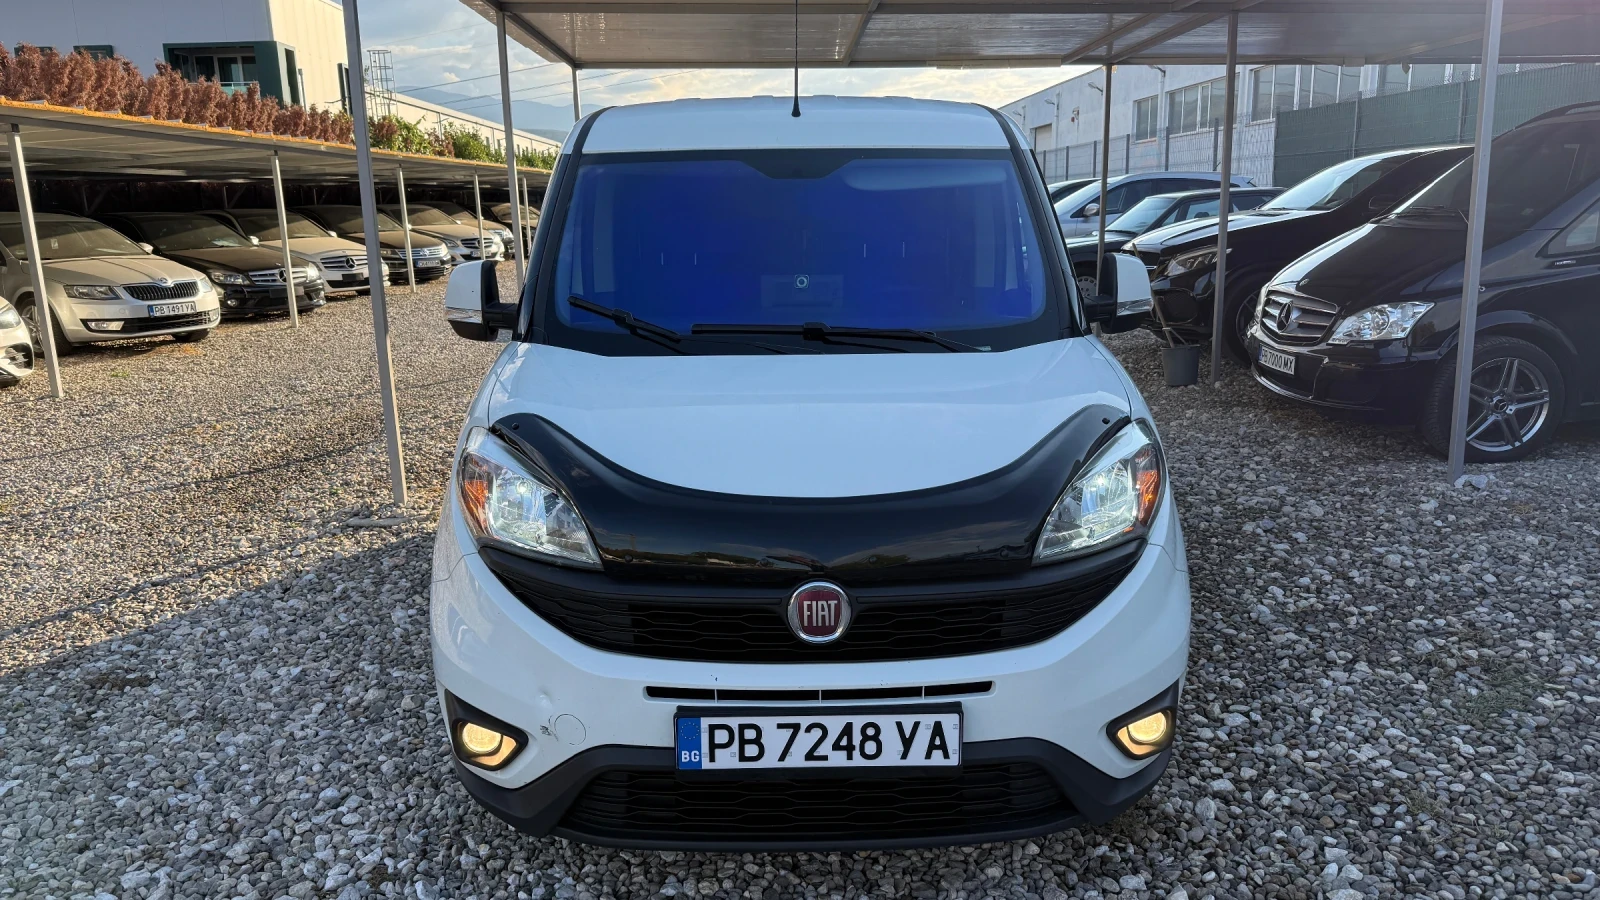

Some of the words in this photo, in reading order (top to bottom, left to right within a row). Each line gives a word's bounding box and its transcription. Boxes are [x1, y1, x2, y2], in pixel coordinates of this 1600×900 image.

[154, 306, 165, 316] PB
[167, 305, 184, 315] 1491
[185, 303, 195, 313] YA
[803, 600, 838, 627] FIAT
[708, 723, 765, 763] PB
[776, 721, 883, 762] 7248
[895, 720, 951, 760] YA
[681, 750, 700, 763] BG
